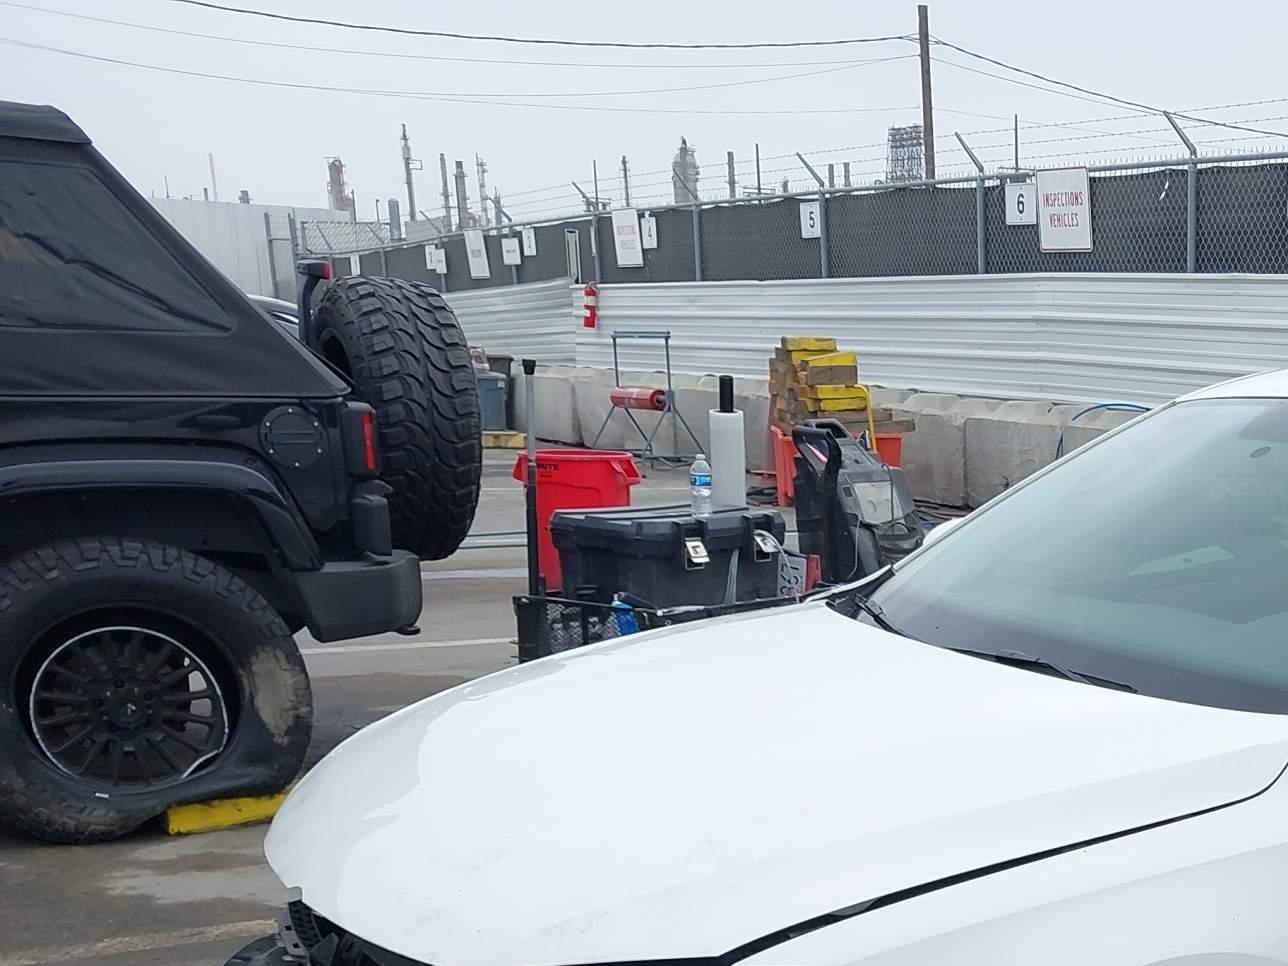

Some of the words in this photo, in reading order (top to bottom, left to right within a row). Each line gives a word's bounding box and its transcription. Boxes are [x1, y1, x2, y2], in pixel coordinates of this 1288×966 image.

[1016, 193, 1025, 215] 6
[1043, 191, 1084, 208] INSPECTIONS
[809, 211, 815, 229] 5
[1049, 212, 1080, 228] VEHICLES
